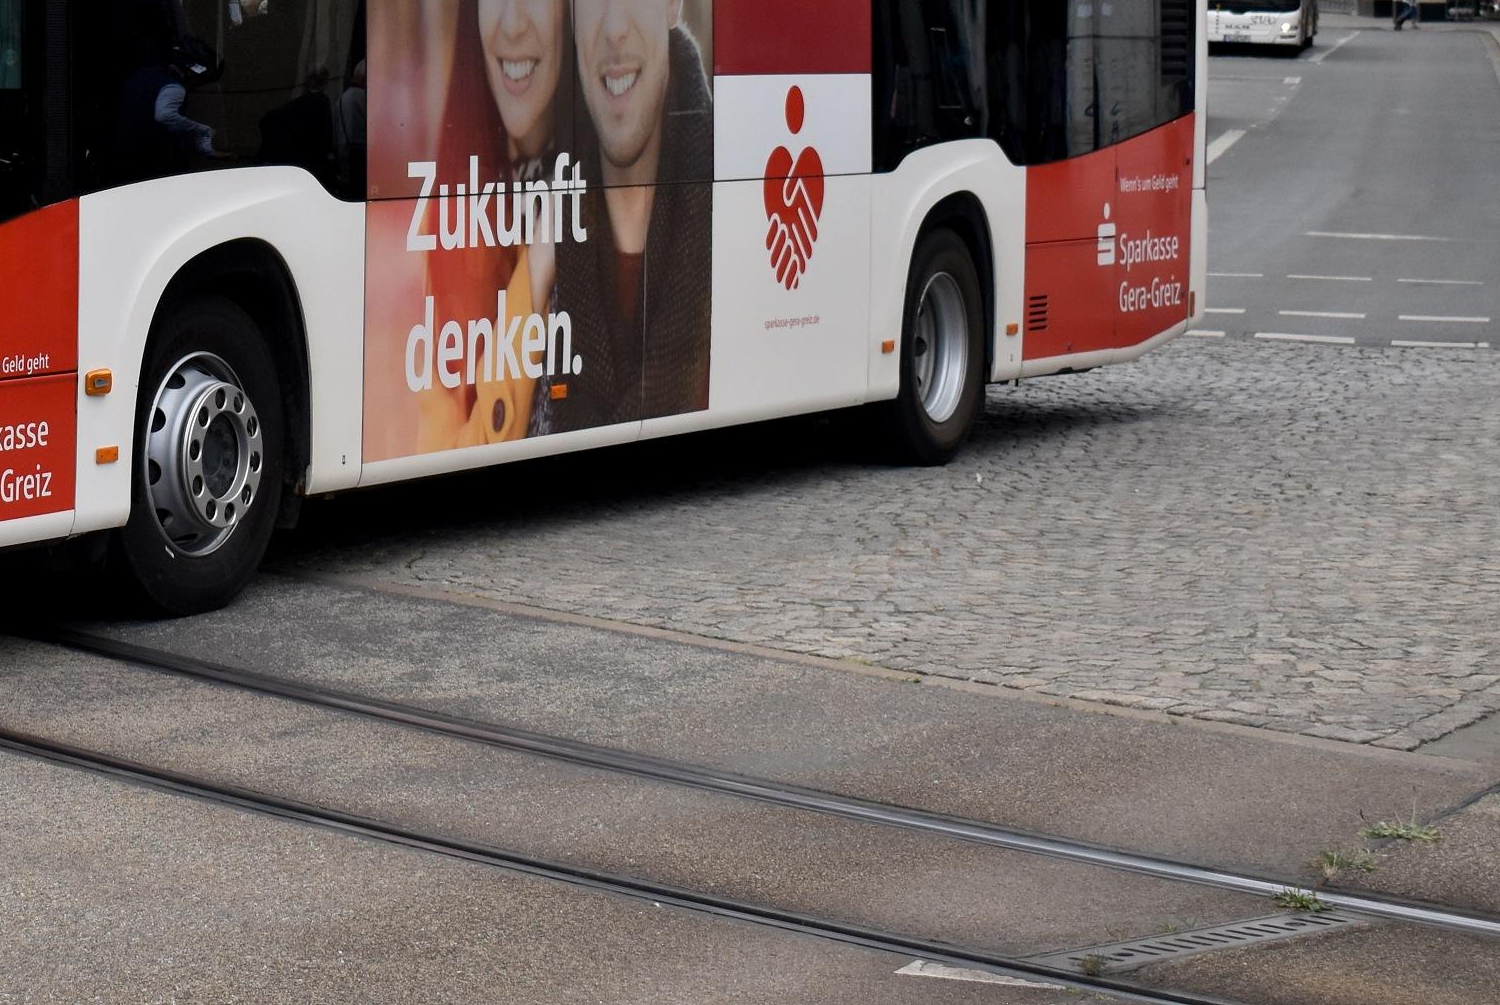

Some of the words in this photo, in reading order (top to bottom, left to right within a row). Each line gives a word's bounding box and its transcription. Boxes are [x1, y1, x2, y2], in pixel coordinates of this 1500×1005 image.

[405, 152, 587, 252] Zukunft
[1120, 175, 1141, 193] Wenn's
[1152, 174, 1165, 191] Geld
[1165, 173, 1179, 194] geht
[1119, 229, 1179, 272] Sparkasse
[1119, 275, 1181, 313] Gera-Greiz
[405, 290, 583, 393] denken.
[2, 354, 25, 373] Geld
[26, 352, 50, 375] geht
